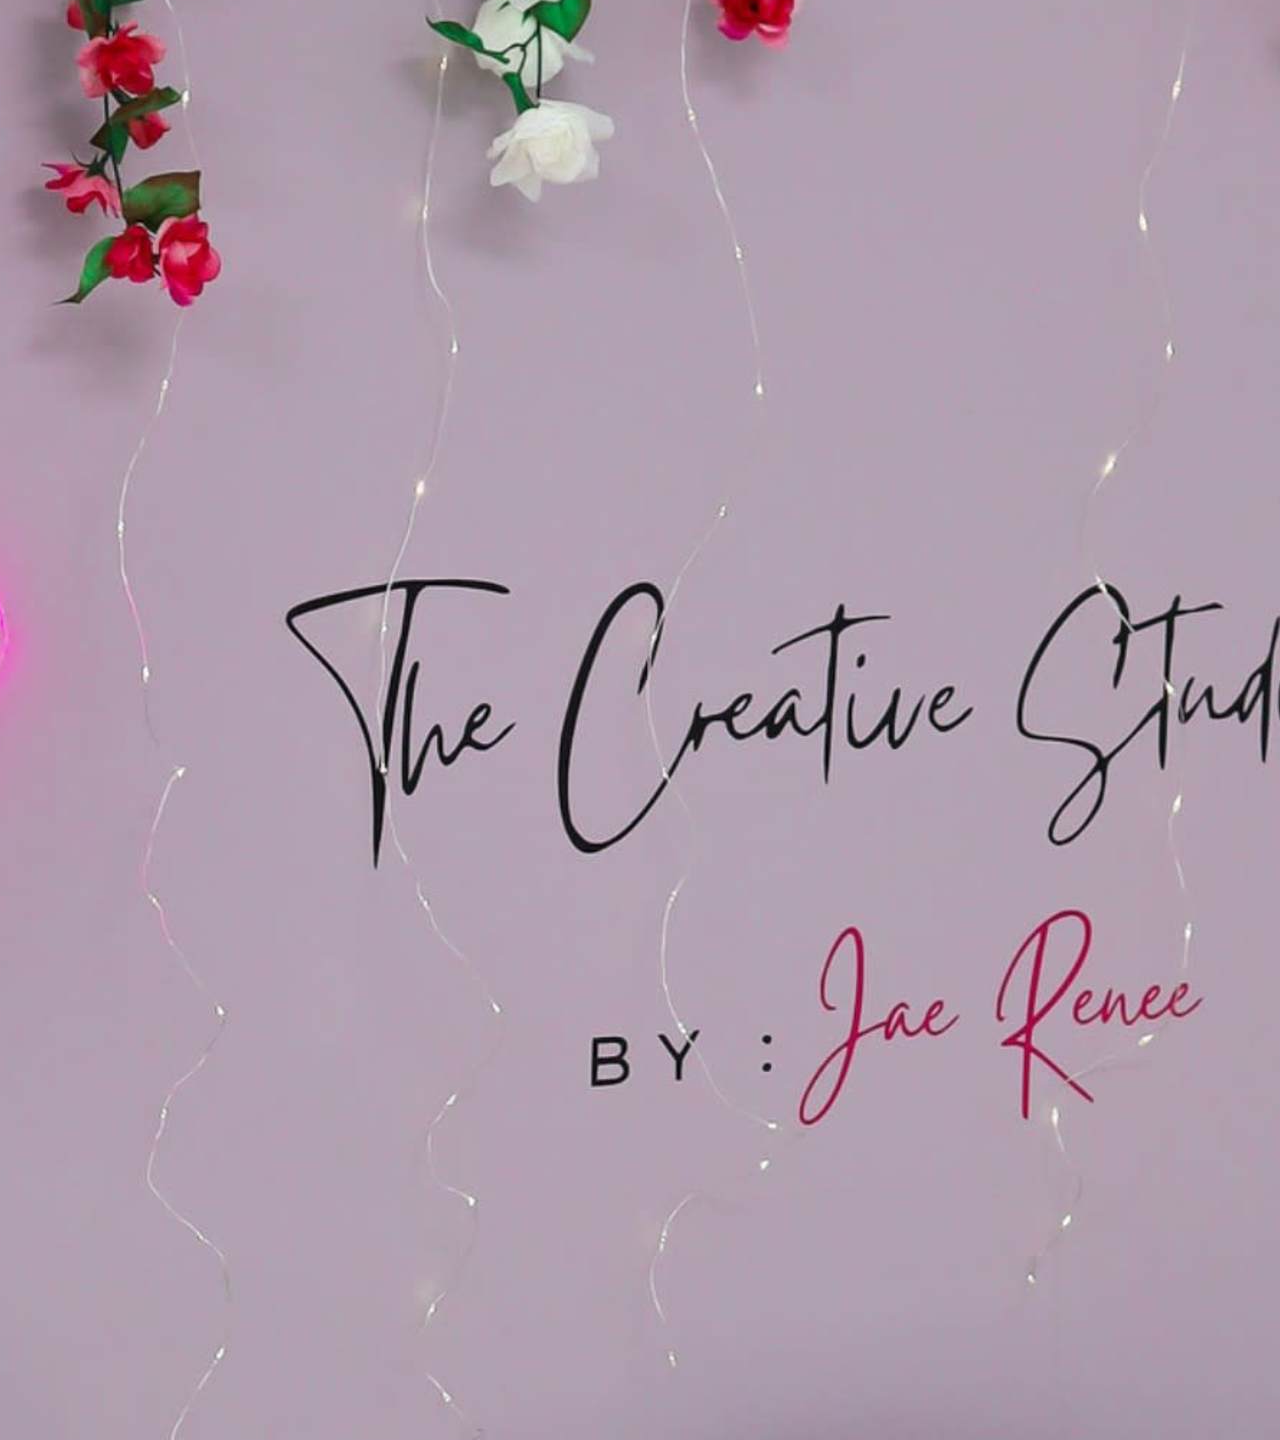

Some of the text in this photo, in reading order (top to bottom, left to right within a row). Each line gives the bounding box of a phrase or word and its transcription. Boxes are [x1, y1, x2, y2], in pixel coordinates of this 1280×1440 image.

[285, 577, 517, 870] The
[557, 581, 974, 854] Creative
[798, 926, 962, 1127] Jae
[994, 909, 1204, 1121] Renee
